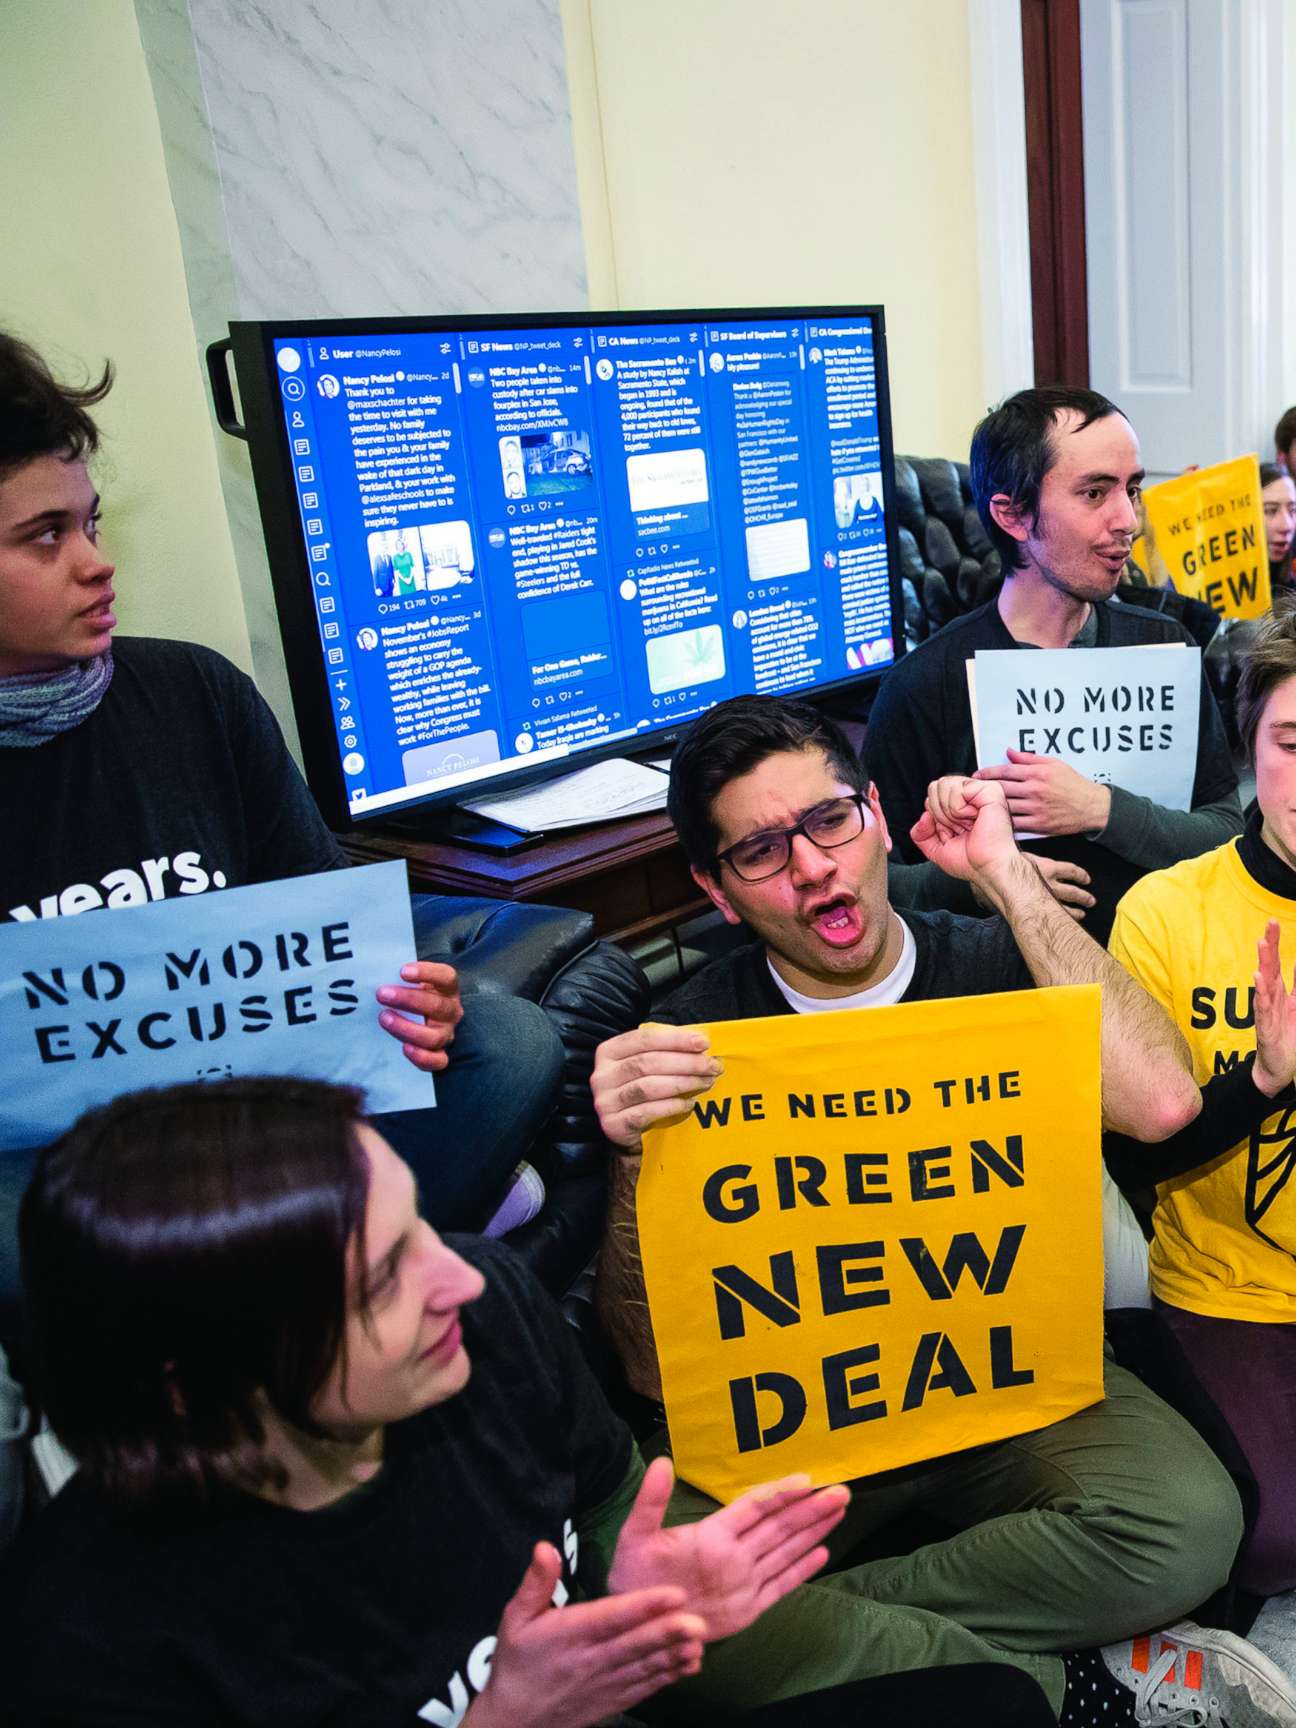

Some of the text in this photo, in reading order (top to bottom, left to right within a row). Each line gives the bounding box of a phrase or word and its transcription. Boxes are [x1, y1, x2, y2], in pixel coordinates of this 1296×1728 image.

[346, 388, 369, 397] Thank
[369, 390, 385, 398] you
[418, 397, 442, 406] taking
[348, 413, 362, 421] the
[390, 410, 406, 418] visit
[407, 408, 424, 417] with
[351, 423, 388, 434] yesterday.
[402, 420, 425, 430] family
[406, 430, 442, 441] subjected
[354, 442, 450, 458] the pain you & your family
[374, 455, 419, 468] experienced
[428, 454, 441, 462] the
[357, 471, 377, 480] wake
[378, 470, 387, 478] of
[387, 468, 403, 477] that
[404, 466, 420, 475] dark
[421, 466, 435, 475] day
[359, 475, 456, 491] Parkland, & your work with
[434, 487, 454, 496] make
[380, 505, 397, 514] they
[419, 501, 437, 509] have
[1168, 518, 1192, 536] WE
[1231, 493, 1252, 511] THE
[365, 517, 399, 528] inspiring.
[1183, 524, 1255, 576] GREEN
[1198, 566, 1258, 614] EW
[1016, 685, 1175, 715] NO MORE
[1018, 724, 1174, 754] EXCUSES
[22, 922, 355, 1009] NO MORE
[35, 979, 360, 1064] EXCUSES
[692, 1070, 1022, 1129] WE NEED THE
[702, 1134, 1025, 1224] GREEN
[711, 1223, 1028, 1341] NEW
[728, 1325, 1035, 1454] DEAL
